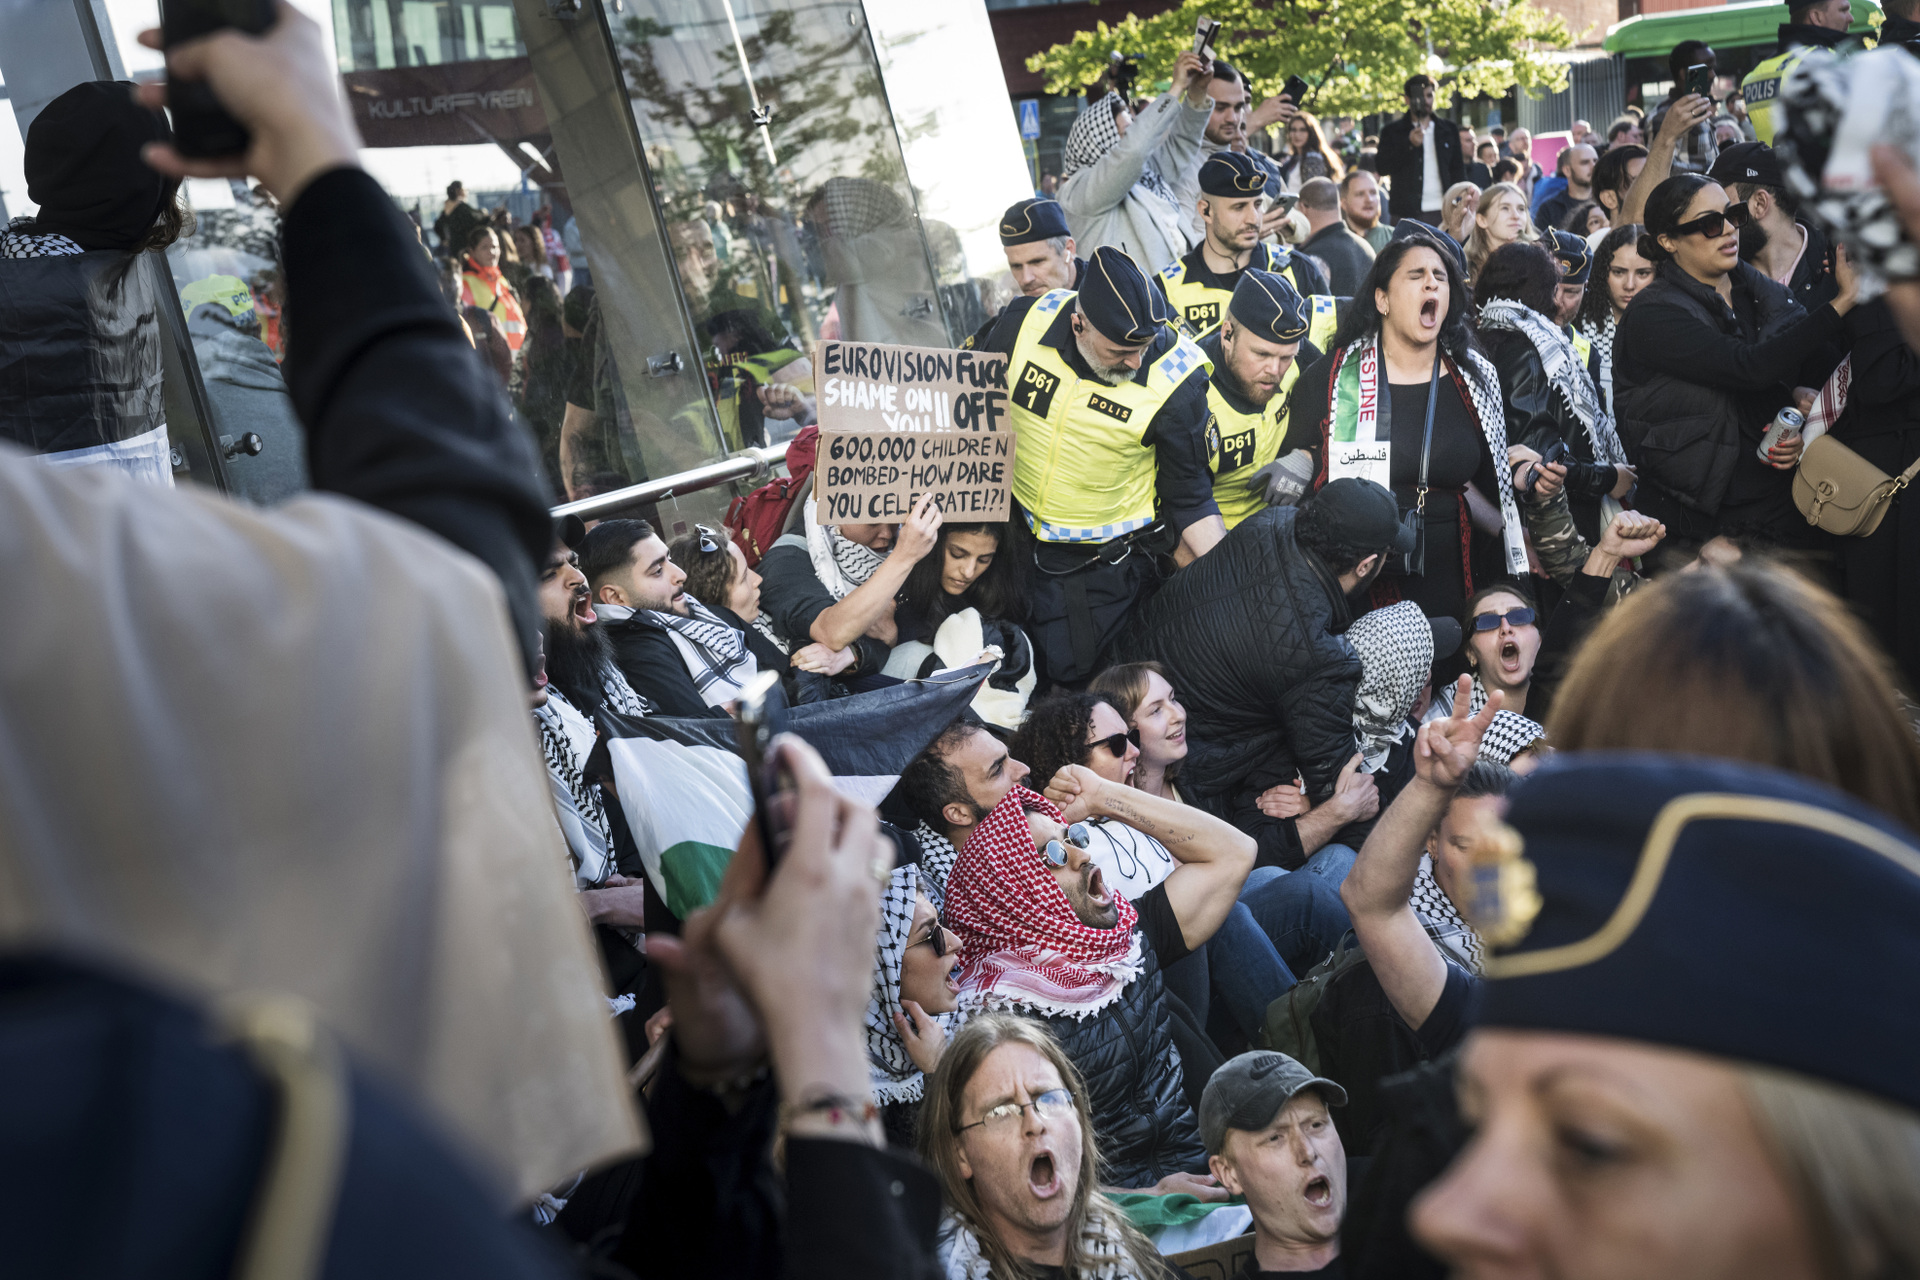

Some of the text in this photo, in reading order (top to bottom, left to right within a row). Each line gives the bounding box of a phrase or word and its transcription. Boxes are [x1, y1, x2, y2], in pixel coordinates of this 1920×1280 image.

[1745, 79, 1775, 102] POLIS
[1189, 304, 1216, 320] D61
[1199, 320, 1208, 331] 1
[824, 343, 952, 384] EUROVISION
[1024, 366, 1054, 393] D61
[1359, 340, 1377, 423] ESTINE
[824, 377, 898, 412] SHAME
[1027, 390, 1038, 410] 1
[953, 391, 1008, 432] OFF
[1090, 397, 1129, 419] POLIS
[830, 436, 916, 464] 600,000
[1224, 432, 1251, 453] D61
[1234, 451, 1242, 467] 1
[1340, 448, 1387, 465] فلسطين
[957, 461, 1005, 485] DARE
[827, 488, 1005, 520] YOU CELERATE!?!
